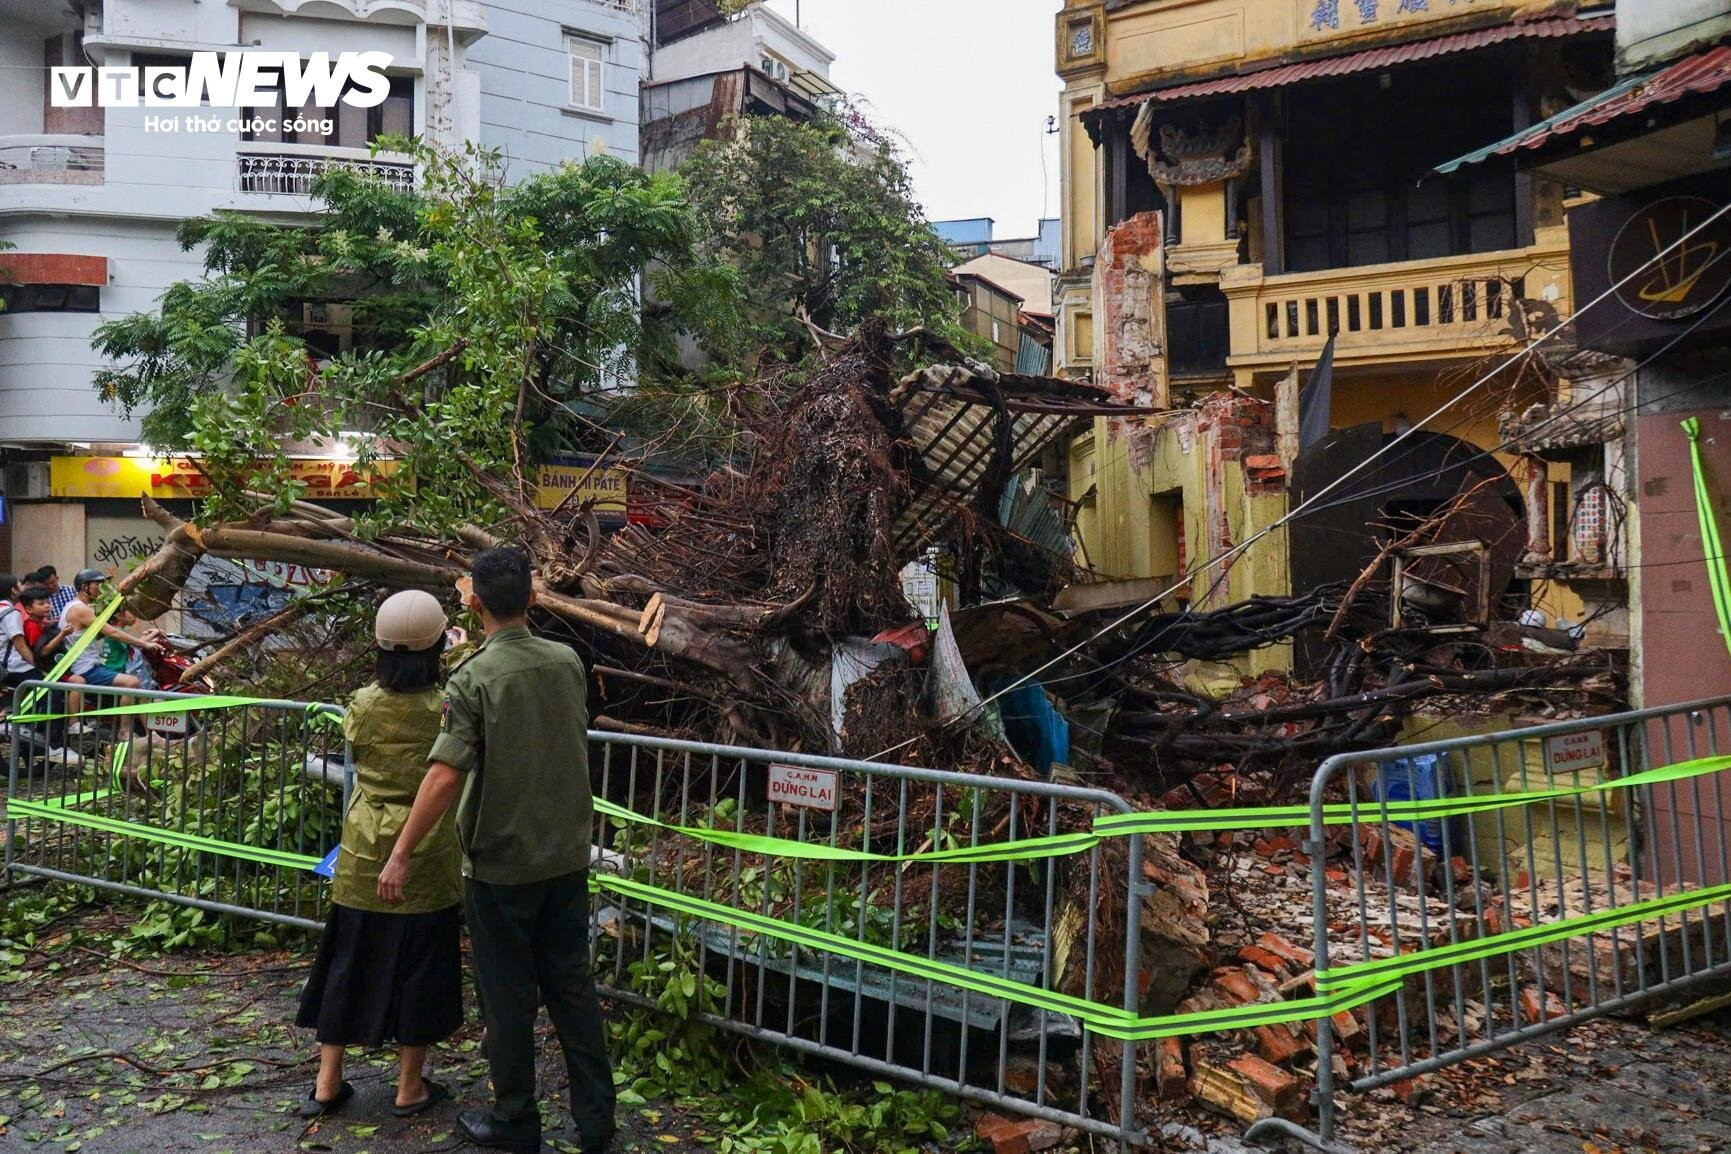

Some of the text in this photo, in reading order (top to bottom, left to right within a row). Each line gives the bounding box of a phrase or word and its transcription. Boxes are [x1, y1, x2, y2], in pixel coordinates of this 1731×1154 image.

[155, 716, 179, 727] STOP
[772, 780, 832, 802] DỪNG LẠI
